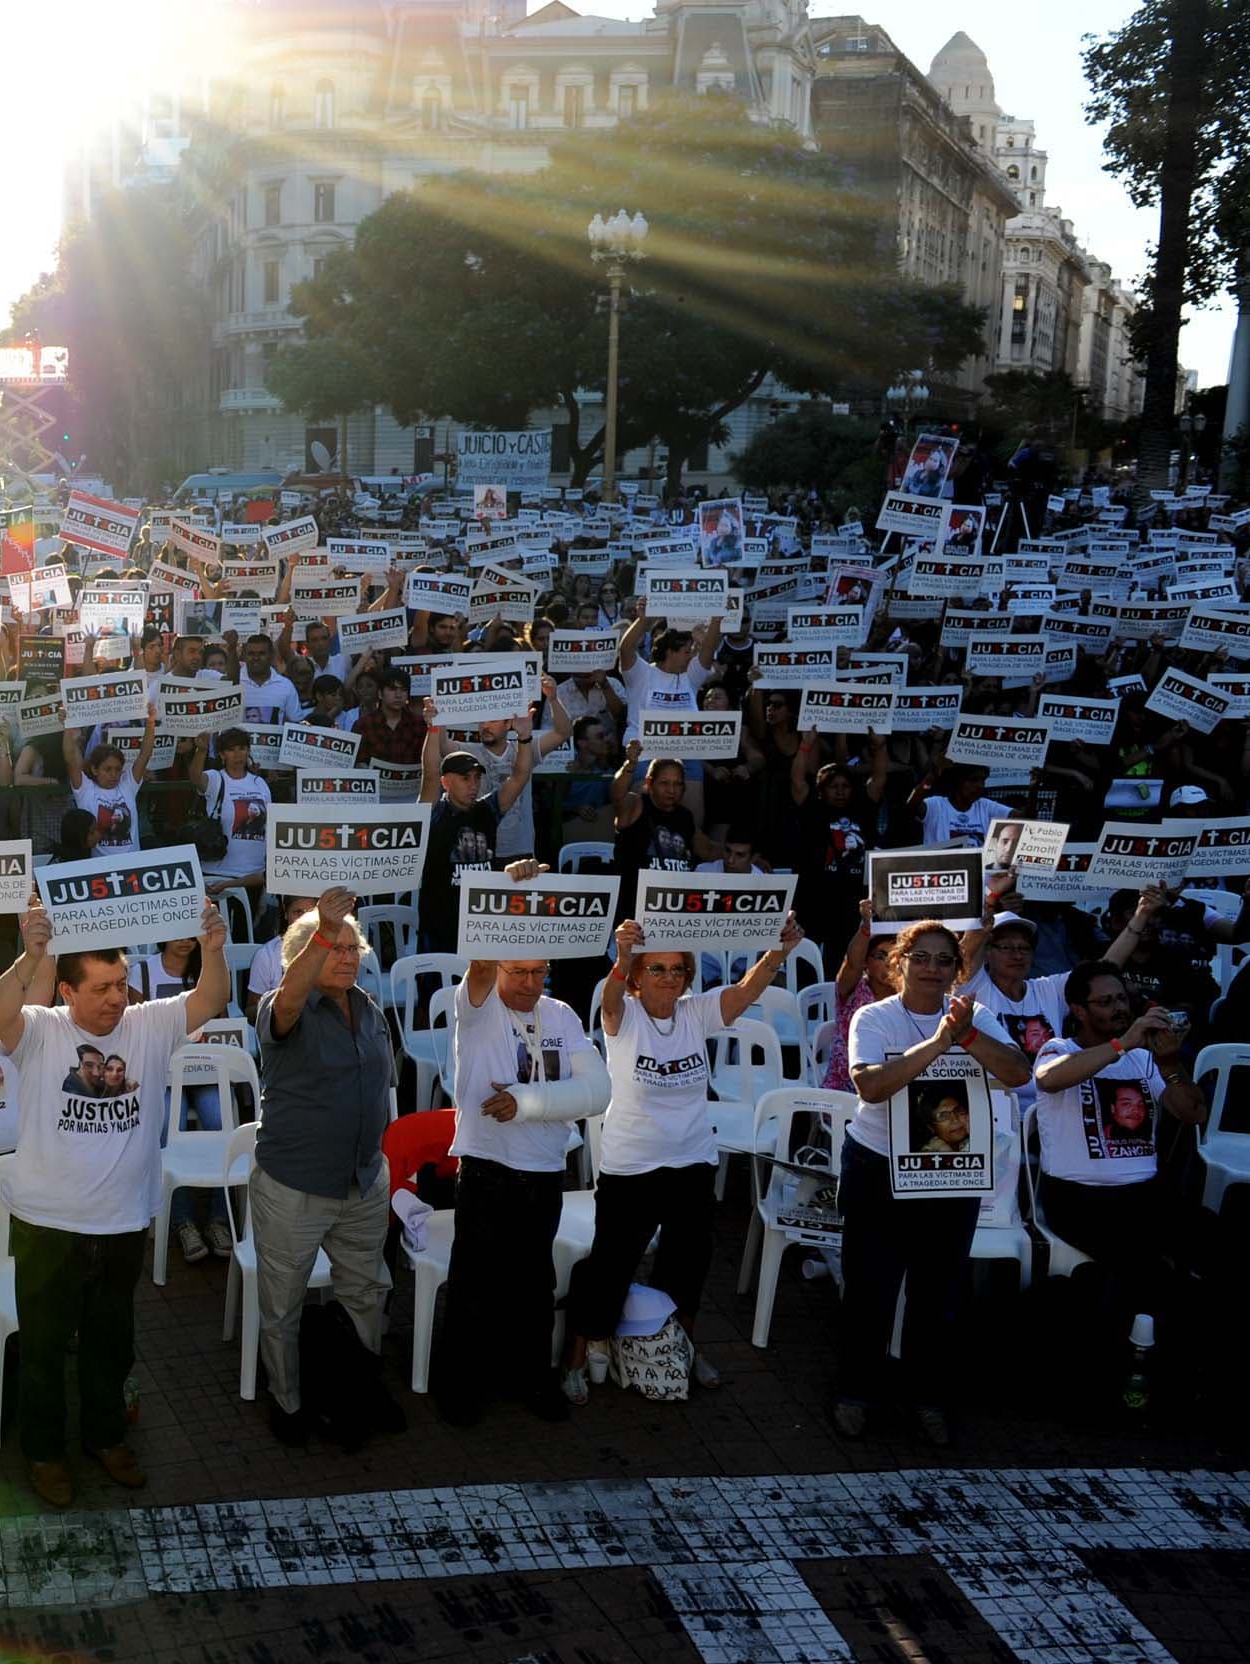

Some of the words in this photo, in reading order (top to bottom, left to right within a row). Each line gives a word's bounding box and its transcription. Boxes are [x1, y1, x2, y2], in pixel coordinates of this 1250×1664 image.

[459, 434, 507, 455] JUICIO
[275, 856, 308, 867] PARA
[310, 857, 335, 867] LAS
[400, 856, 418, 866] DE
[274, 868, 289, 878] LA
[291, 869, 356, 880] TRAGEDIA
[359, 870, 376, 880] DE
[379, 868, 415, 879] ONCE
[51, 910, 84, 924] PARA
[86, 907, 111, 920] LAS
[179, 896, 196, 908] DE
[53, 925, 68, 936] LA
[69, 917, 135, 934] TRAGEDIA
[138, 915, 156, 926] DE
[159, 909, 197, 924] ONCE
[467, 922, 500, 933] PARA
[503, 924, 527, 934] LAS
[589, 924, 605, 934] DE
[466, 934, 481, 944] LA
[483, 935, 547, 945] TRAGEDIA
[549, 937, 566, 945] DE
[568, 935, 602, 945] ONCE
[950, 1060, 972, 1068] PARA
[932, 1068, 982, 1078] SCIDONE
[62, 1095, 140, 1122] JUSTICIA
[57, 1119, 75, 1132] POR
[77, 1121, 109, 1134] MATIAS
